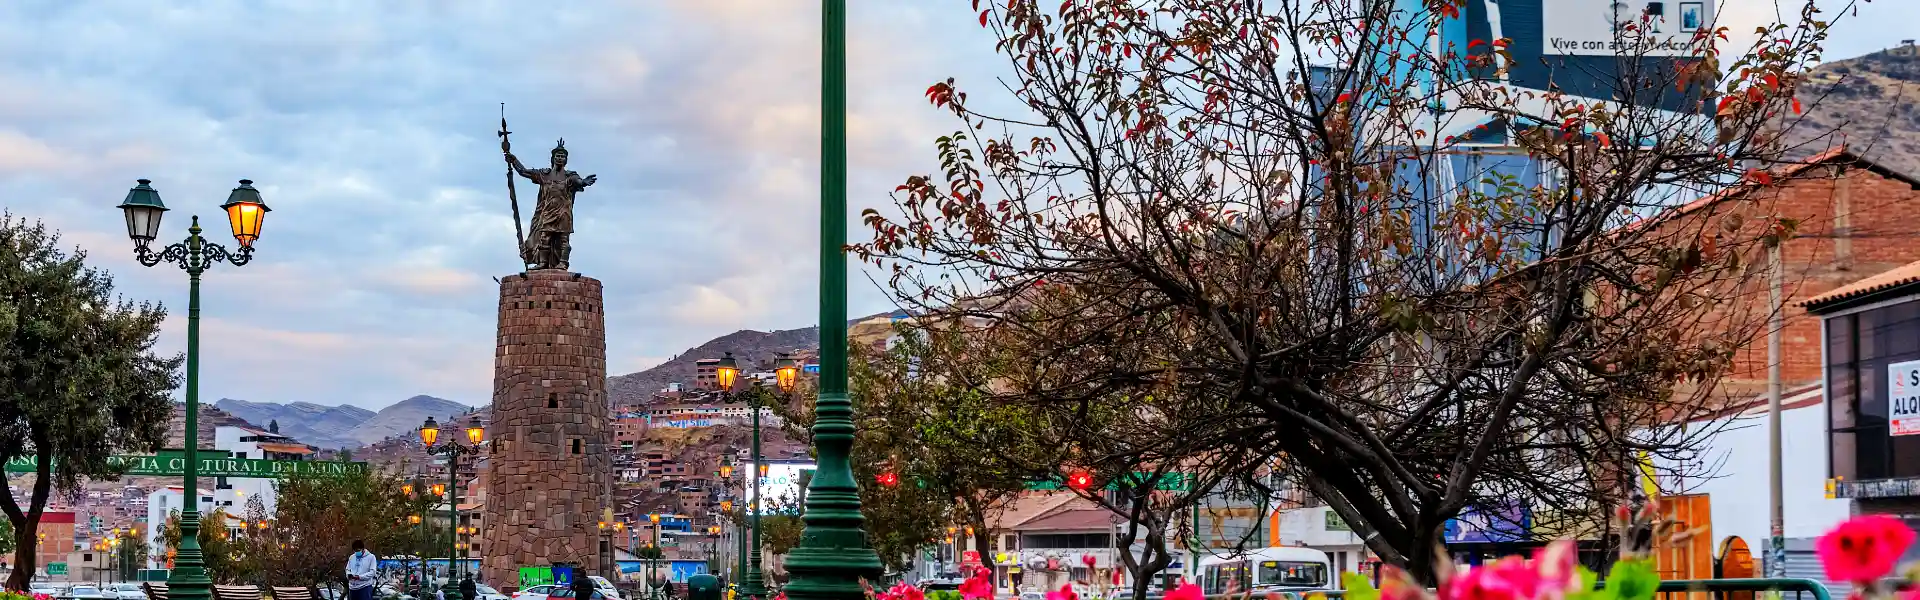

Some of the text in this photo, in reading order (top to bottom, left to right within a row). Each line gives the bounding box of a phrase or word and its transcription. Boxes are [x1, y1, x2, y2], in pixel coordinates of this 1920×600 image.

[1550, 37, 1578, 50] Vive
[1582, 40, 1605, 50] con
[1893, 396, 1920, 416] ALQ
[169, 458, 263, 472] CTURAL
